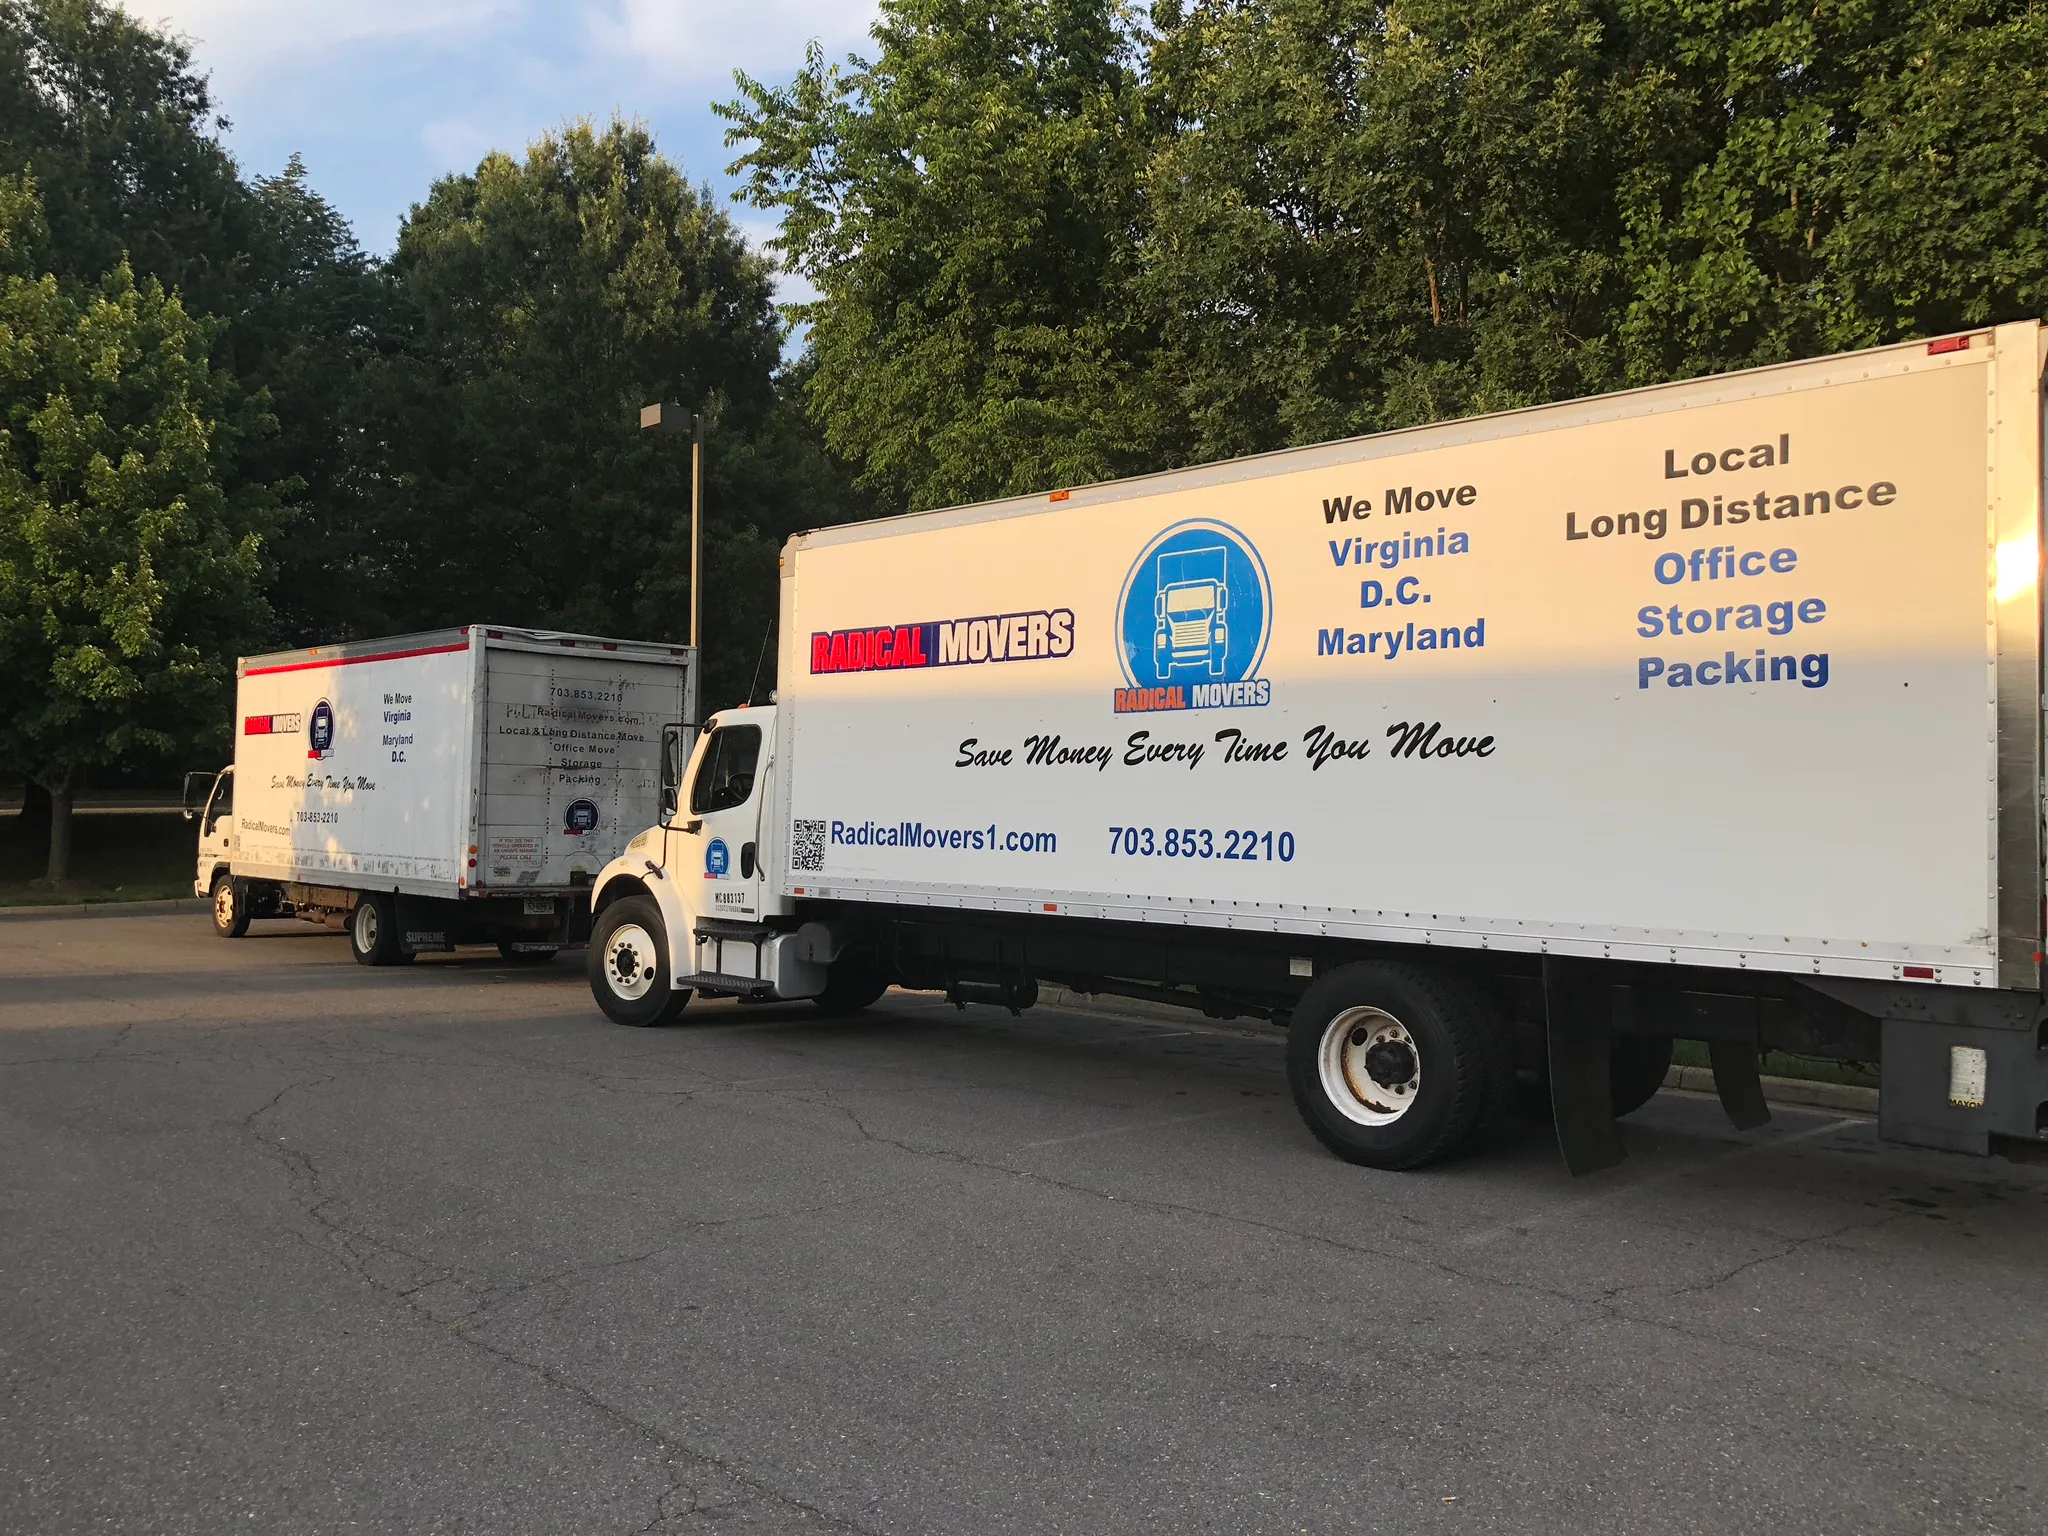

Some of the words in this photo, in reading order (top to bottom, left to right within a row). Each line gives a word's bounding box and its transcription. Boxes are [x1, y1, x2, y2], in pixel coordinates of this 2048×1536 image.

[1664, 433, 1789, 479] Local
[1322, 496, 1372, 524] We
[1384, 484, 1477, 516] Move
[1566, 507, 1667, 541] Long
[1680, 481, 1897, 530] Distance
[1328, 527, 1470, 569] Virginia
[1654, 546, 1797, 585] Office
[1360, 576, 1431, 609] D.C.
[1636, 598, 1827, 638] Storage
[810, 627, 927, 675] RADICAL
[937, 608, 1074, 664] MOVERS
[1317, 618, 1485, 661] Maryland
[1638, 649, 1829, 689] Packing
[383, 693, 394, 705] We
[395, 693, 412, 705] Move
[550, 687, 623, 703] 703.853.2210
[1114, 686, 1187, 713] RADICAL
[1191, 678, 1271, 709] MOVERS
[272, 713, 301, 733] MOVERS
[383, 710, 411, 723] Virginia
[382, 733, 414, 747] Maryland
[499, 726, 529, 736] Local
[533, 727, 540, 736] &
[543, 727, 568, 739] Long
[570, 730, 616, 740] Distance
[618, 732, 645, 742] Move
[553, 743, 584, 753] Office
[589, 744, 616, 754] Move
[954, 737, 1014, 769] Save
[1023, 734, 1113, 771] Money
[1123, 730, 1206, 771] Every
[1215, 728, 1289, 763] Time
[1302, 724, 1371, 772] You
[1384, 721, 1496, 761] Move
[391, 751, 406, 763] D.C.
[561, 758, 602, 770] Storage
[286, 774, 305, 791] Money
[306, 773, 324, 791] Every
[325, 775, 340, 790] Time
[342, 775, 356, 791] You
[357, 775, 376, 791] Move
[559, 774, 601, 786] Packing
[241, 818, 291, 837] RadicalMovers.com
[296, 811, 339, 824] 703-853-2210
[830, 820, 1058, 853] RadicalMovers1.com
[1108, 826, 1295, 862] 703.853.2210
[406, 931, 446, 943] SUPREME
